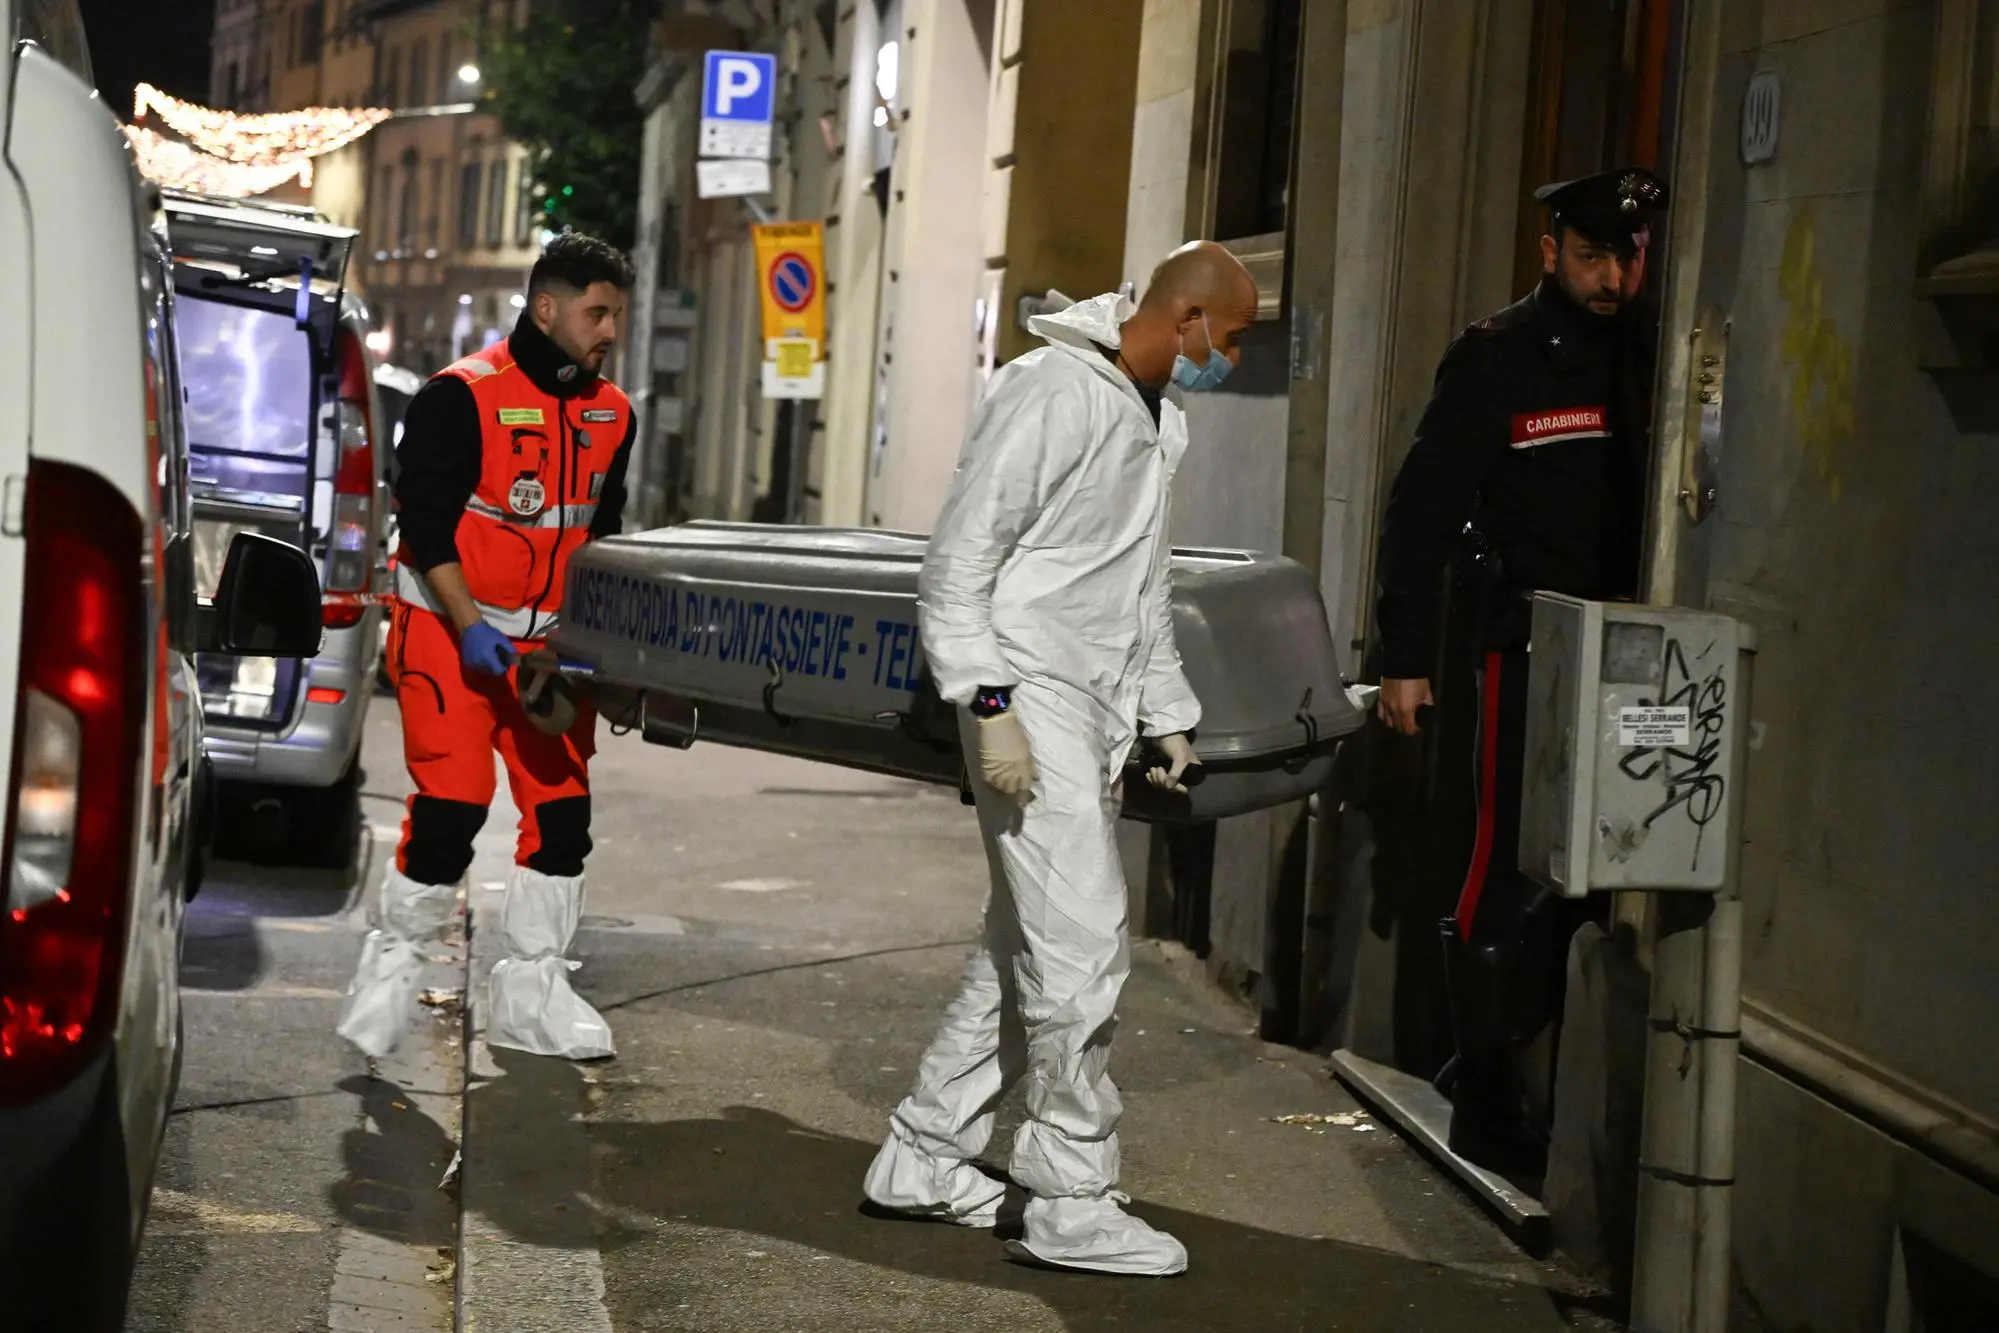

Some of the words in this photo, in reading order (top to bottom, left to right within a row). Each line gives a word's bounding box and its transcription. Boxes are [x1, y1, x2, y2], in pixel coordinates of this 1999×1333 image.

[715, 58, 762, 116] P
[1747, 86, 1773, 147] 99
[1526, 412, 1601, 433] CARABINIERI
[569, 564, 679, 649] MISERICORDIA
[681, 591, 705, 656] DI
[703, 597, 855, 680] PONTASSIEVE
[1650, 713, 1686, 722] SERRANDE
